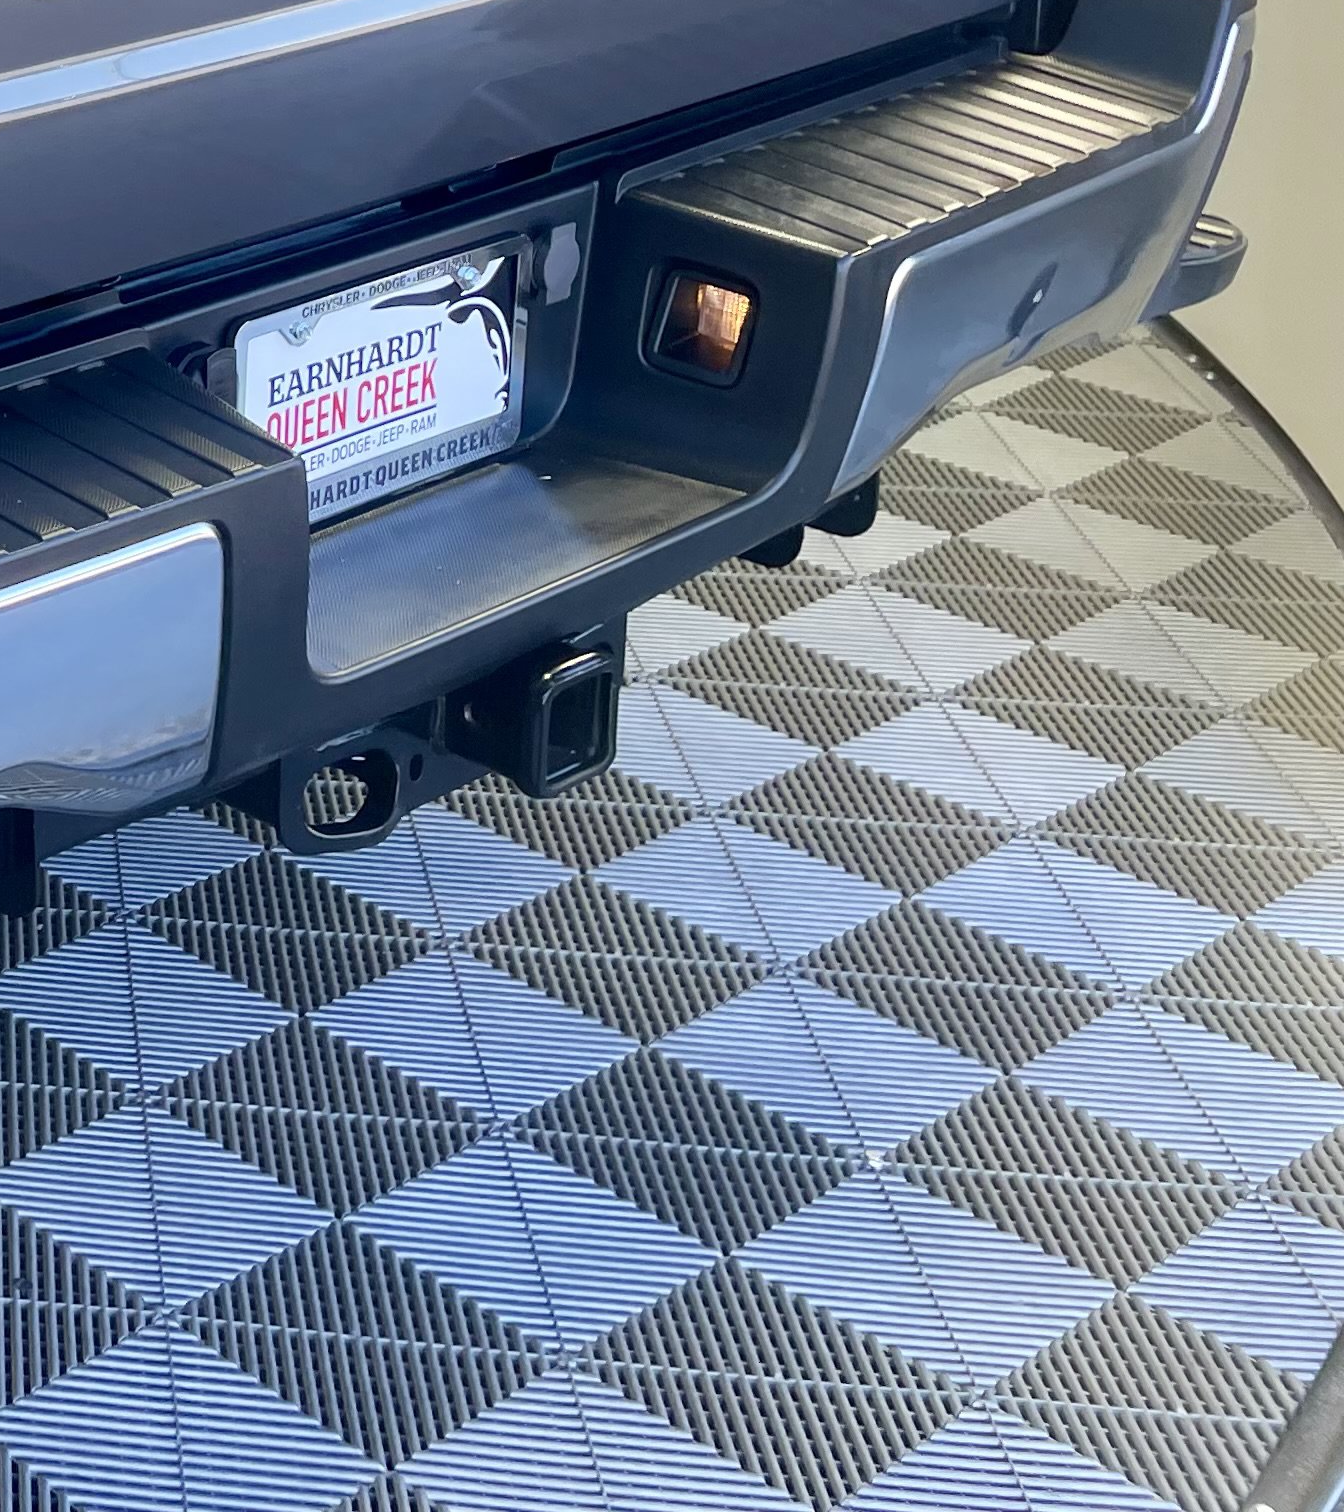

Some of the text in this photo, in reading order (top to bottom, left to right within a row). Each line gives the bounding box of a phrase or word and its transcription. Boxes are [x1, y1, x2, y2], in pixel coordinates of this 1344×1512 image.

[301, 291, 360, 319] CHRYSLER
[267, 322, 443, 408] EARNHARDT
[357, 357, 438, 424] CREEK
